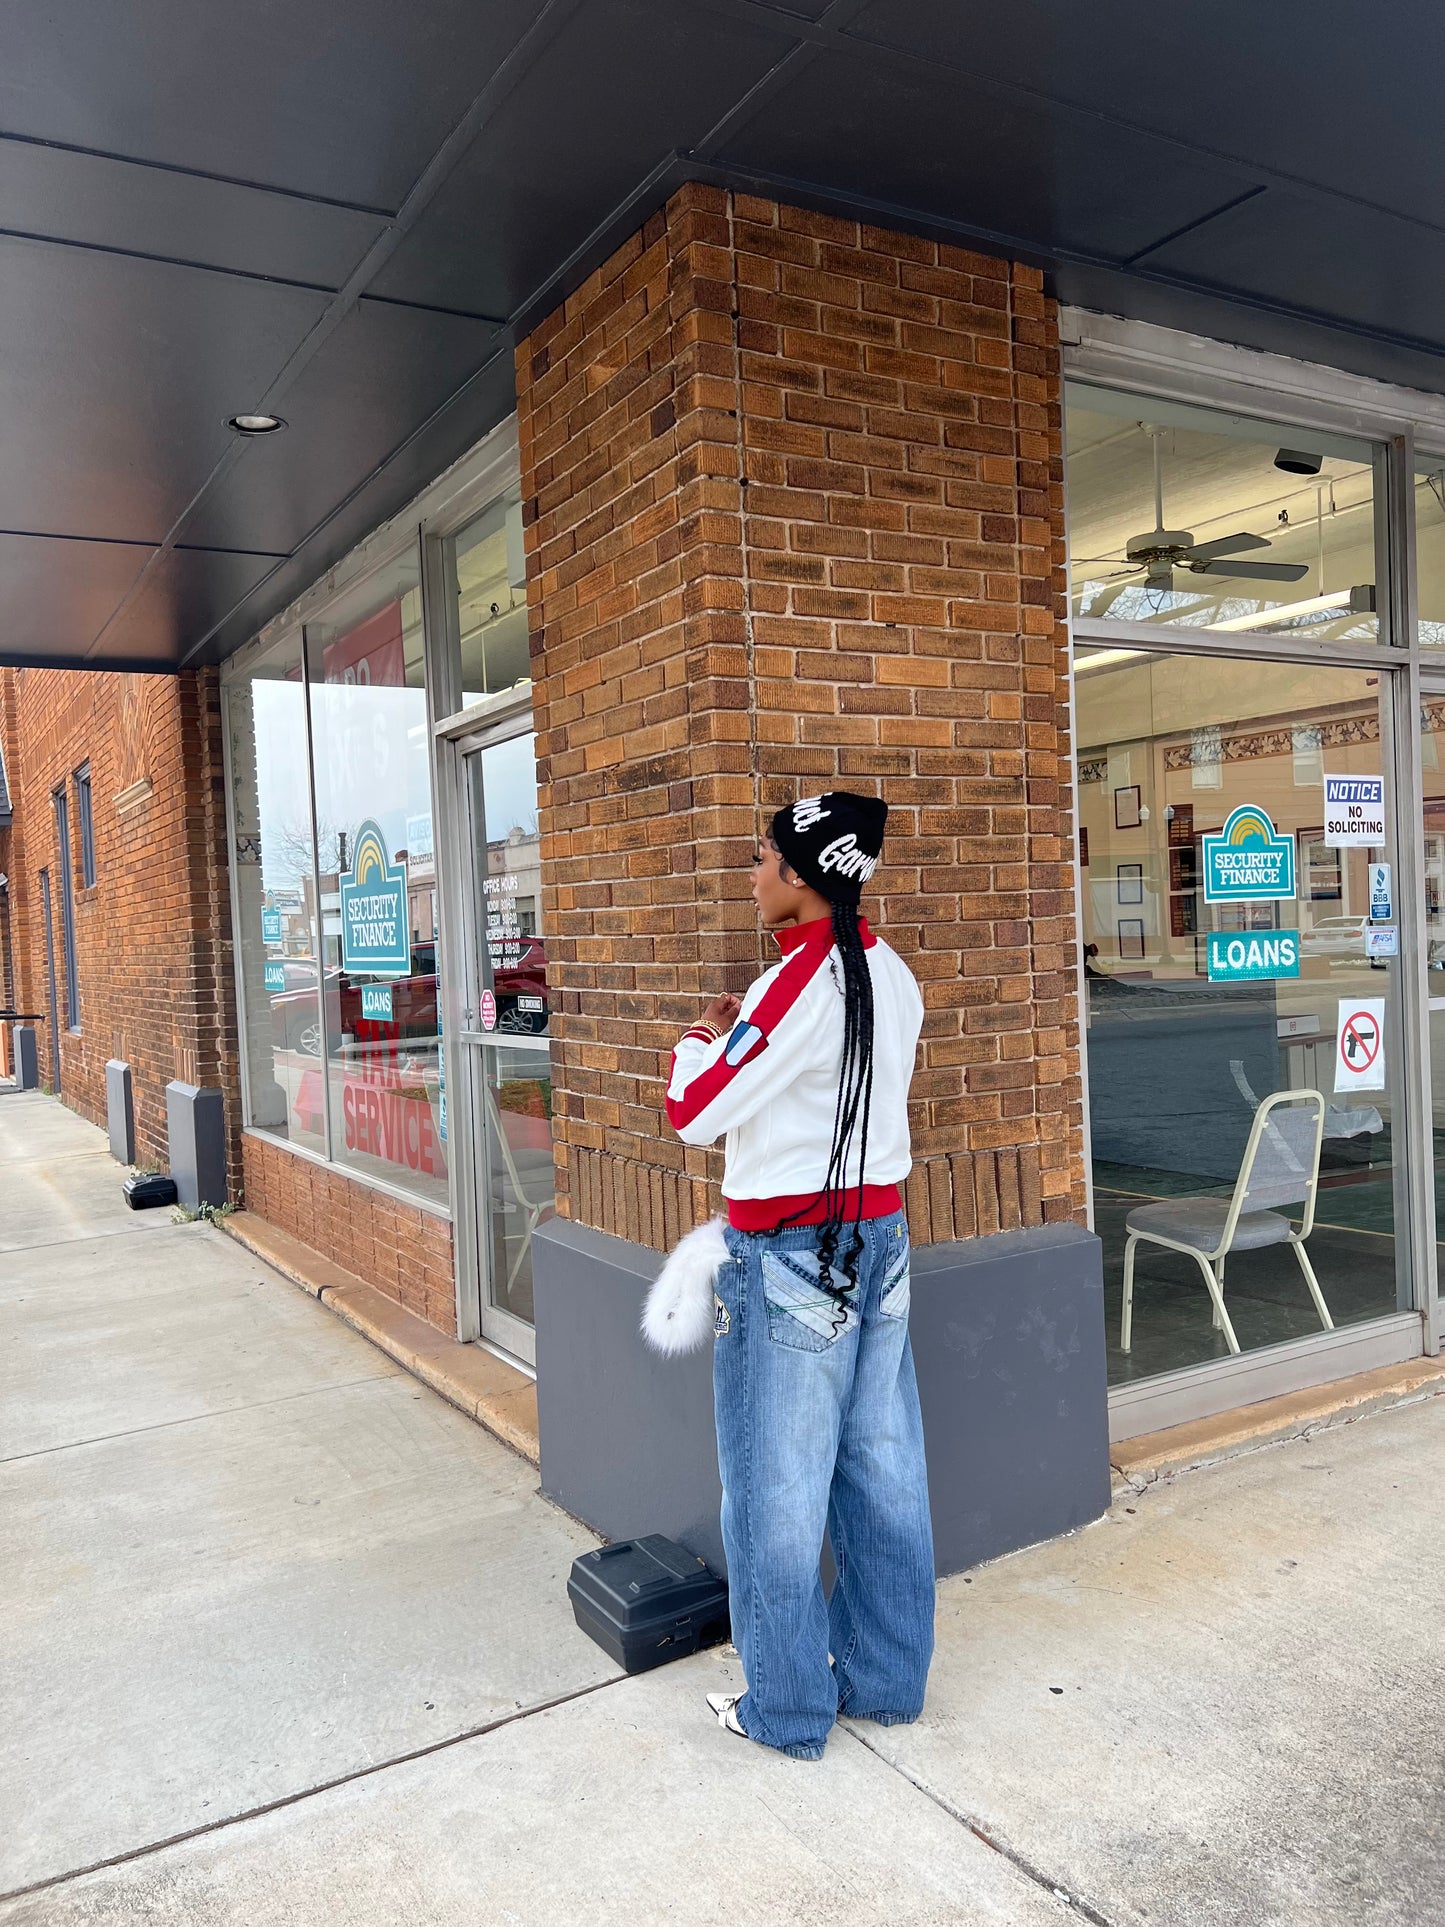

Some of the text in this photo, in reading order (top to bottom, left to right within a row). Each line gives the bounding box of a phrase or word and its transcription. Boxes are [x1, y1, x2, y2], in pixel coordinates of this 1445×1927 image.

[1328, 782, 1380, 800] NOTICE
[1348, 806, 1363, 818] NO
[409, 821, 431, 841] AVISO
[1328, 821, 1383, 833] SOLICITING
[409, 853, 433, 866] SOLICITAR
[1215, 852, 1284, 869] SECURITY
[483, 875, 518, 894] OFFICE HOURS
[1220, 869, 1280, 885] FINANCE
[1373, 893, 1388, 903] BBB
[349, 893, 398, 922] SECURITY
[352, 921, 396, 948] FINANCE
[1379, 934, 1393, 942] AFSA
[1212, 938, 1296, 969] LOANS
[265, 967, 284, 983] LOANS
[363, 989, 391, 1013] LOANS
[356, 1020, 402, 1089] TAX
[344, 1085, 433, 1175] SERVICE
